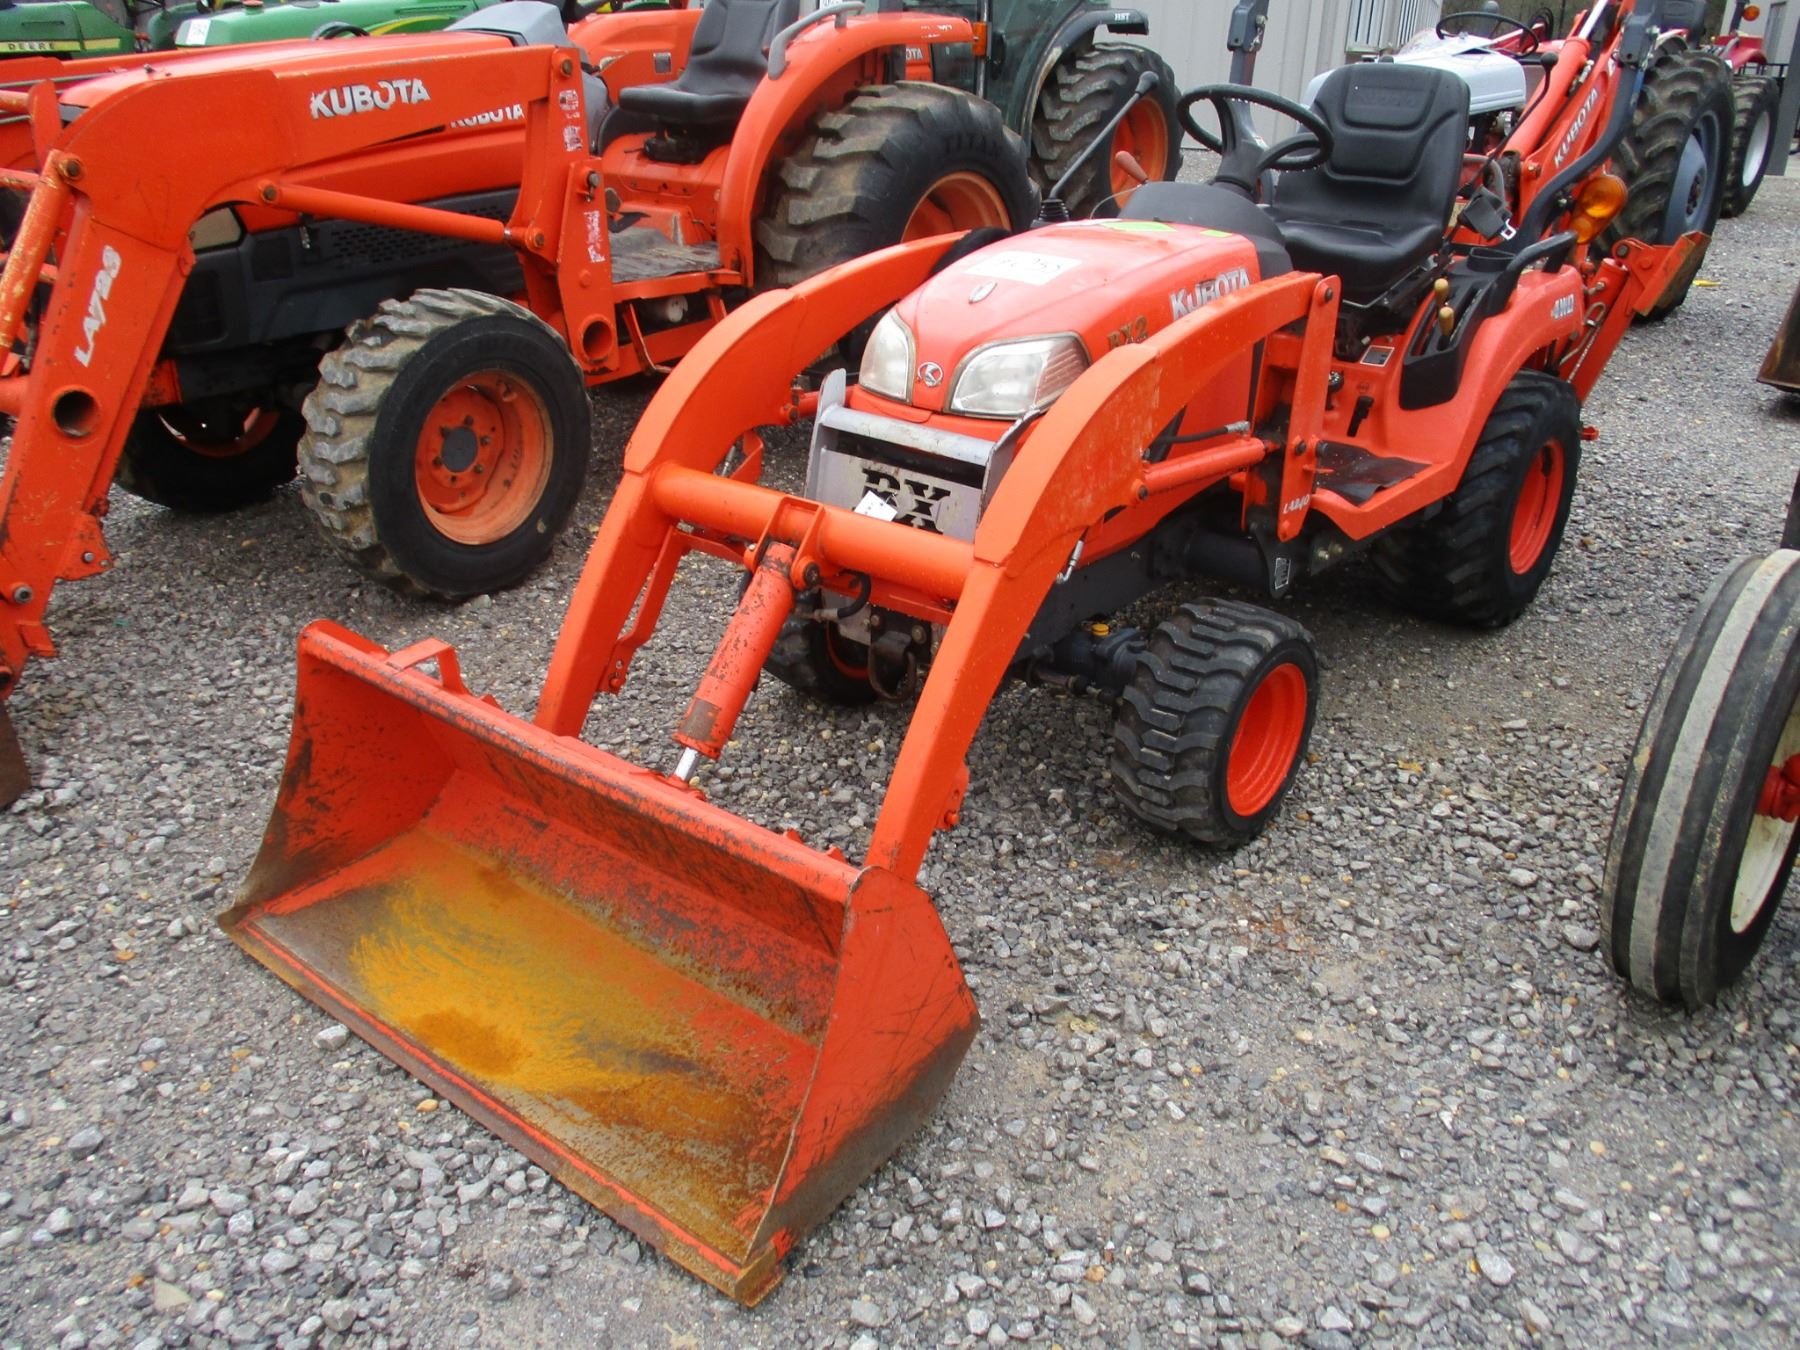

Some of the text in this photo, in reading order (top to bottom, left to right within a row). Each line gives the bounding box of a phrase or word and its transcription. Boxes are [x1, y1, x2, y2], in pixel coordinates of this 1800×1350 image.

[8, 40, 56, 51] DEERE
[310, 77, 431, 120] KUBOTA
[1554, 87, 1598, 168] KUBOTA
[1169, 266, 1250, 322] KUBOTA
